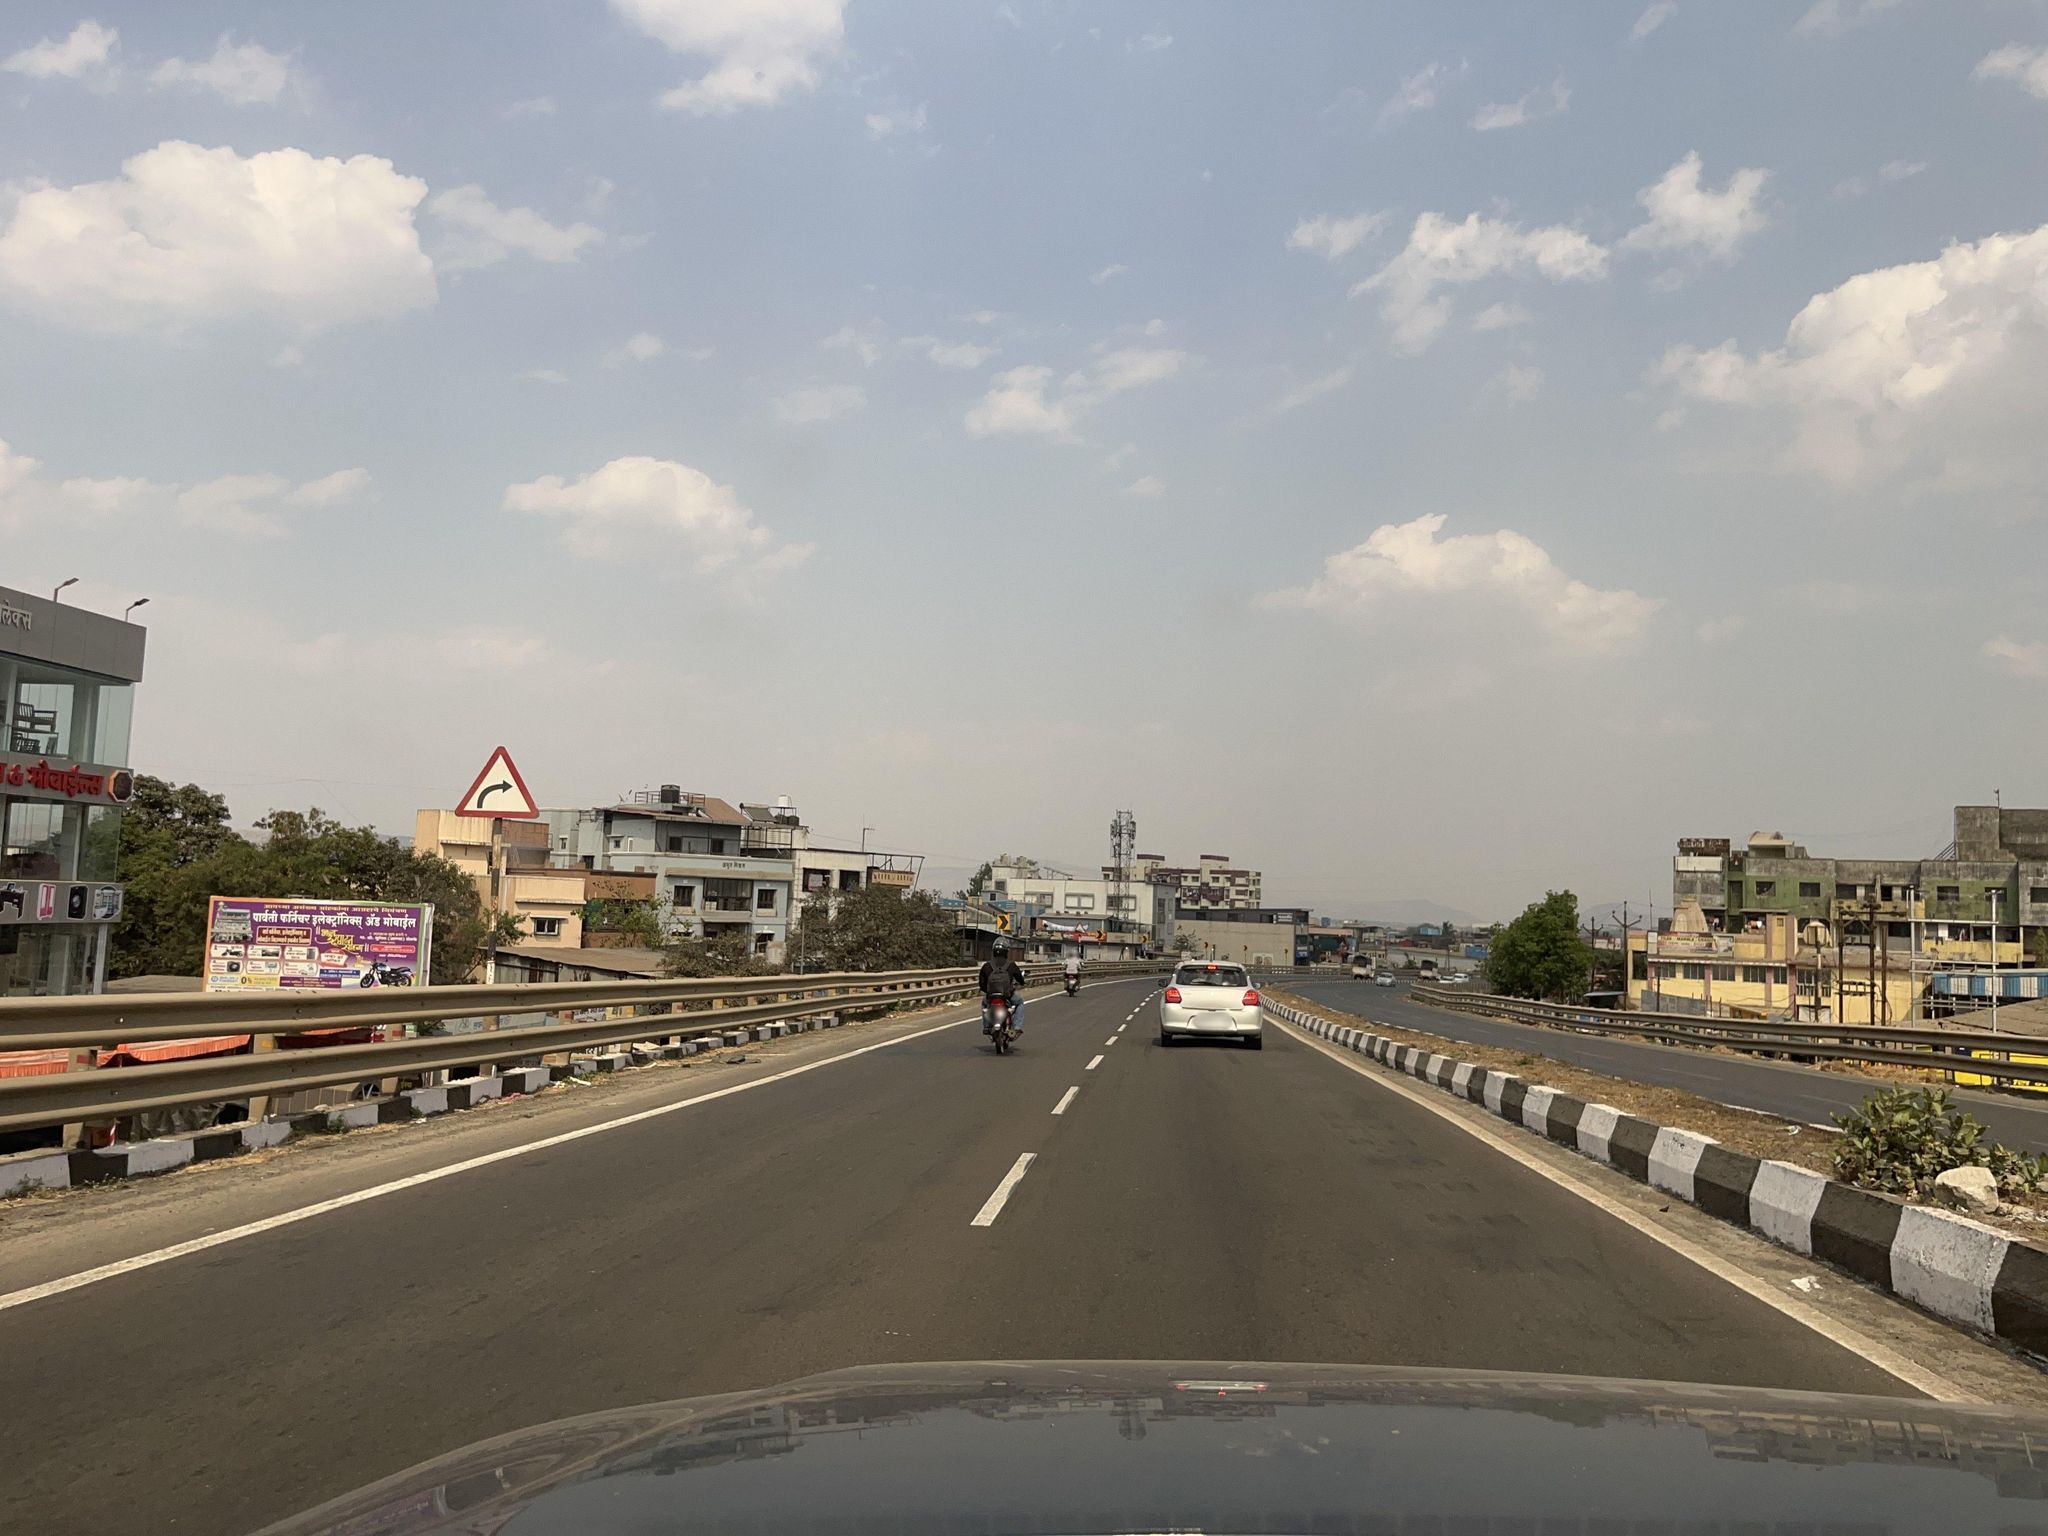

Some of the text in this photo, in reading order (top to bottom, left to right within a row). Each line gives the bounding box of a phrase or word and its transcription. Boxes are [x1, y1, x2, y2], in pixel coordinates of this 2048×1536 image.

[0, 599, 32, 631] लेक्स
[252, 909, 278, 924] पार्वती
[279, 910, 311, 926] फर्निचर
[383, 913, 417, 930] मोबाईल
